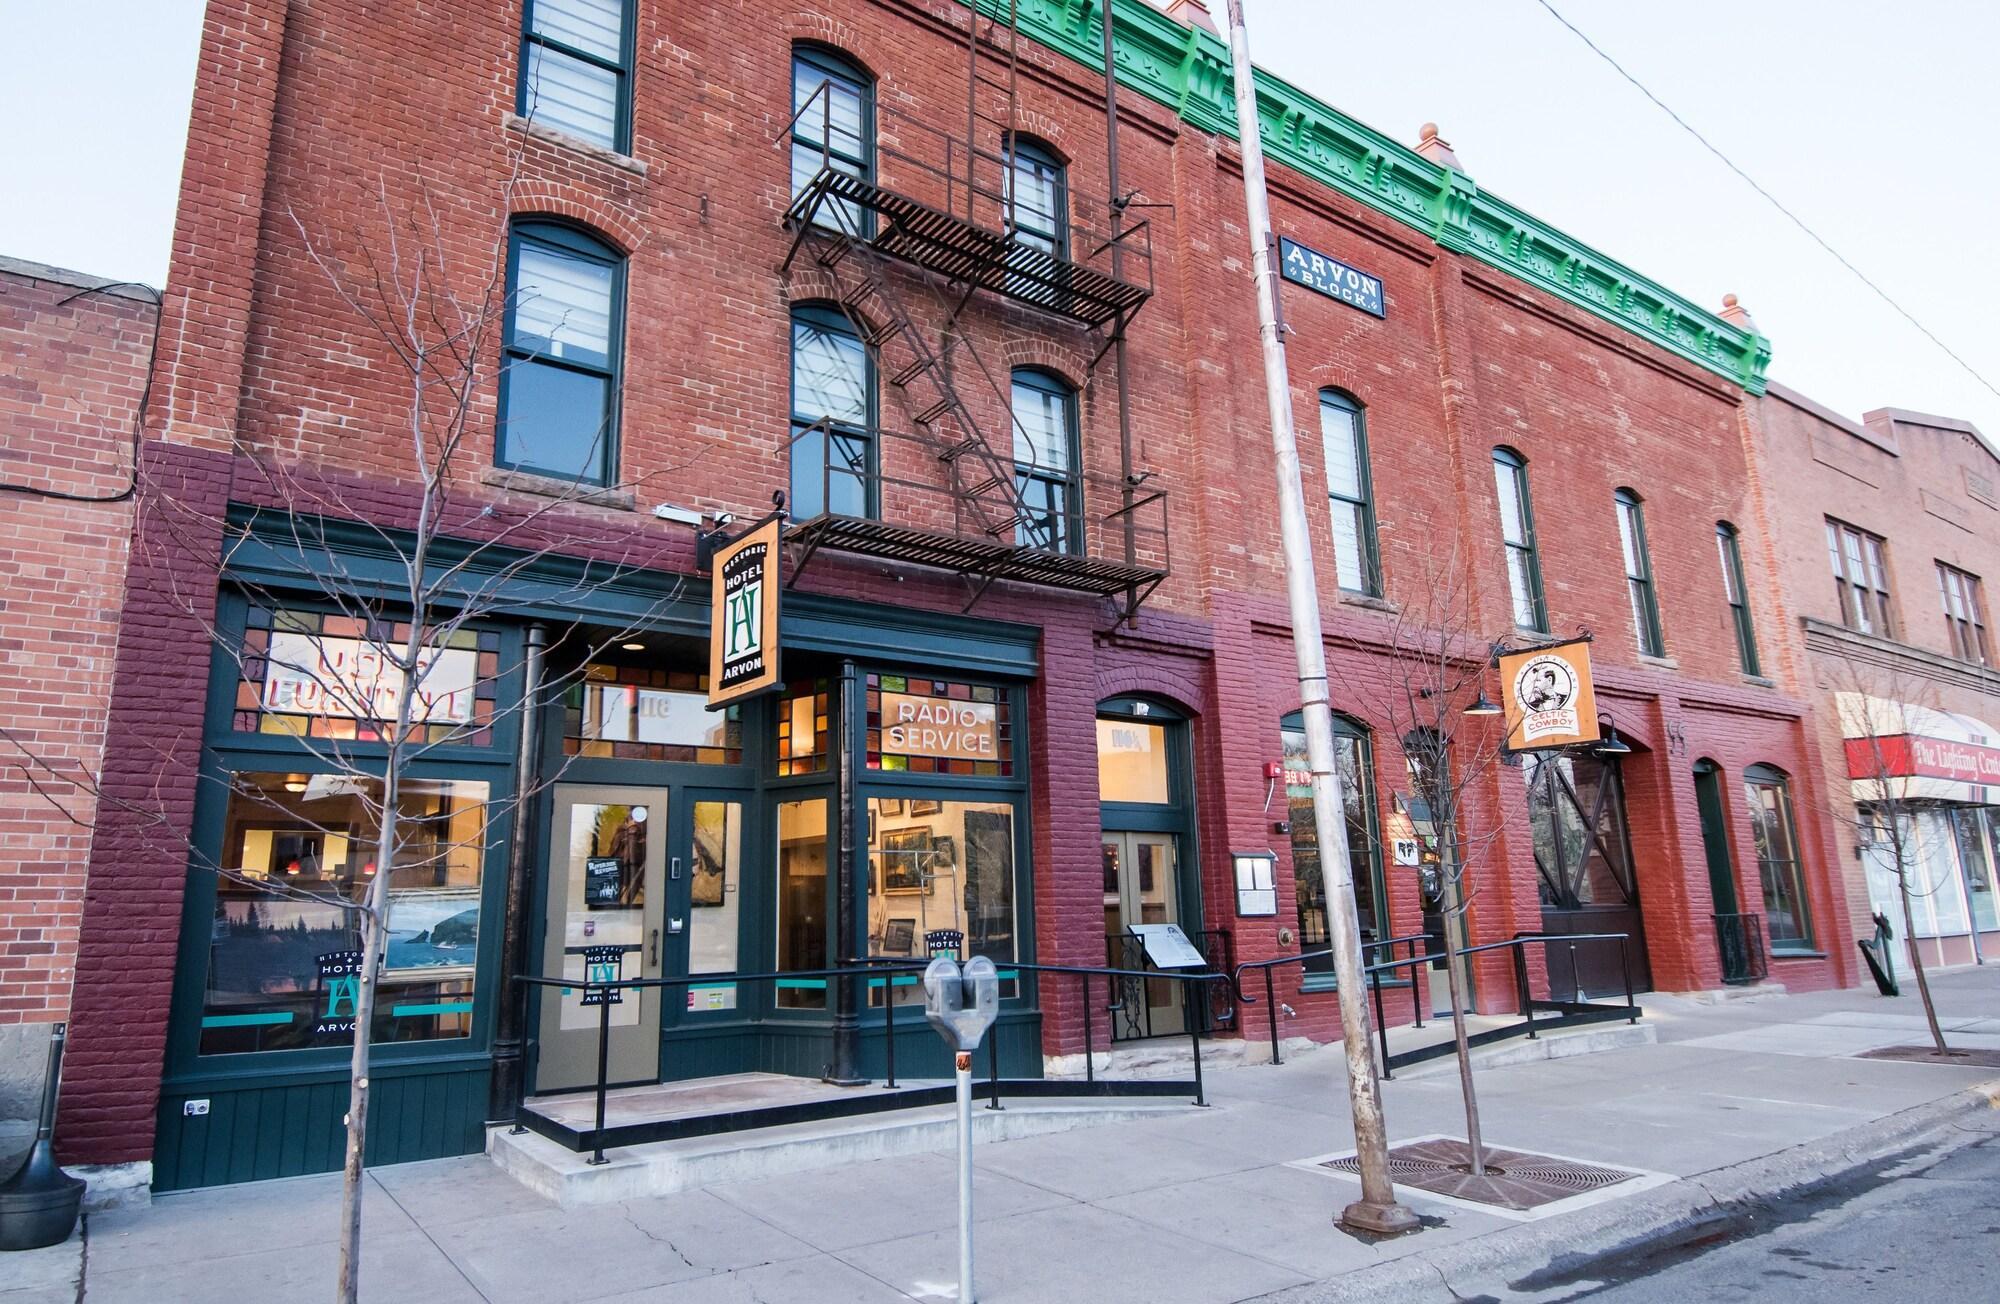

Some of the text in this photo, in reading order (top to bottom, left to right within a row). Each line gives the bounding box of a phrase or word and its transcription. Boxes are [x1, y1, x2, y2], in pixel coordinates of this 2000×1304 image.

[1287, 245, 1377, 298] ARVON
[724, 544, 767, 573] HISTORIC
[726, 563, 763, 590] HOTEL
[724, 656, 762, 680] ARVON
[897, 702, 977, 728] RADIO
[1531, 710, 1568, 722] CELTIC
[1528, 718, 1574, 732] COWBOY
[889, 726, 991, 753] SERVICE
[1913, 741, 2000, 781] The Lighting Cent
[930, 940, 960, 949] HOTEL
[319, 951, 364, 962] HISTO
[322, 964, 363, 974] HOTE
[585, 994, 619, 1002] ARN
[317, 1022, 357, 1033] ARVO
